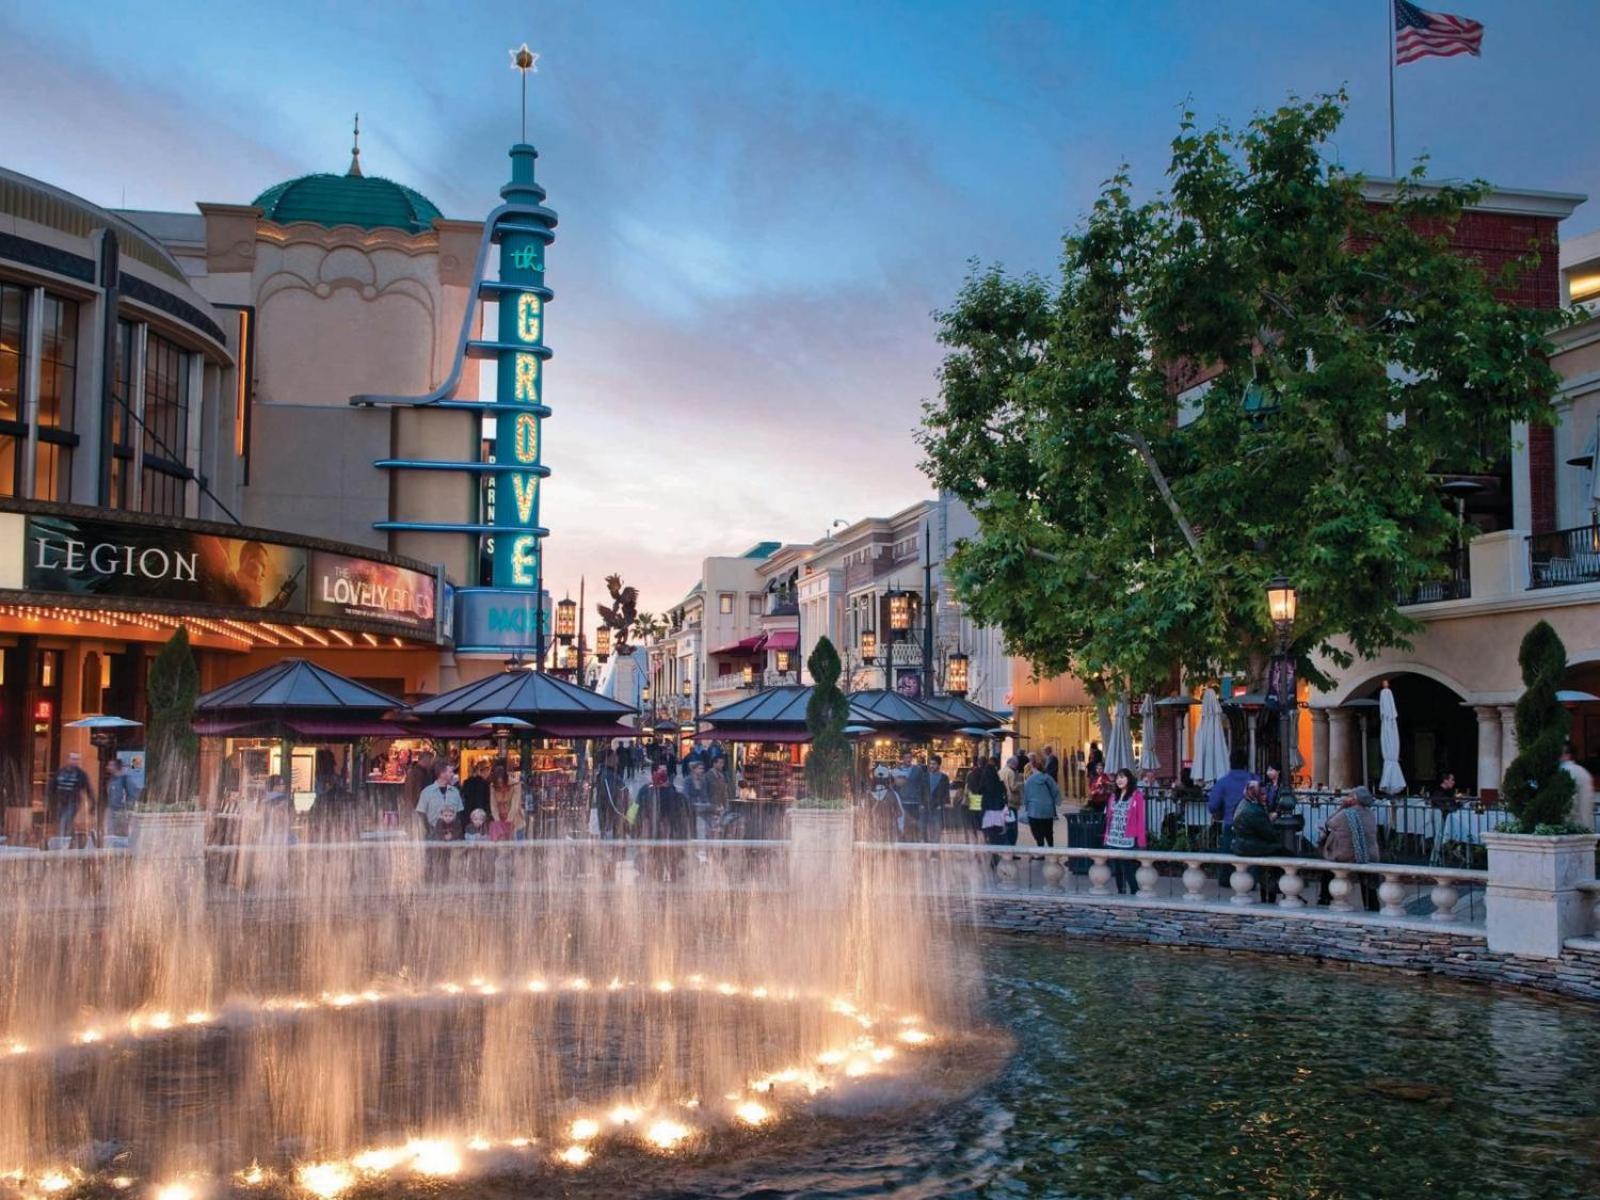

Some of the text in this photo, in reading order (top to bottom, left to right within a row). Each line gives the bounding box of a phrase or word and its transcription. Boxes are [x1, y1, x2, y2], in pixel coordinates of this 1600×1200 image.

[510, 244, 545, 273] the
[512, 291, 541, 586] GROVE
[34, 537, 199, 582] LEGION
[334, 566, 350, 579] THE
[322, 575, 389, 608] LOVELY
